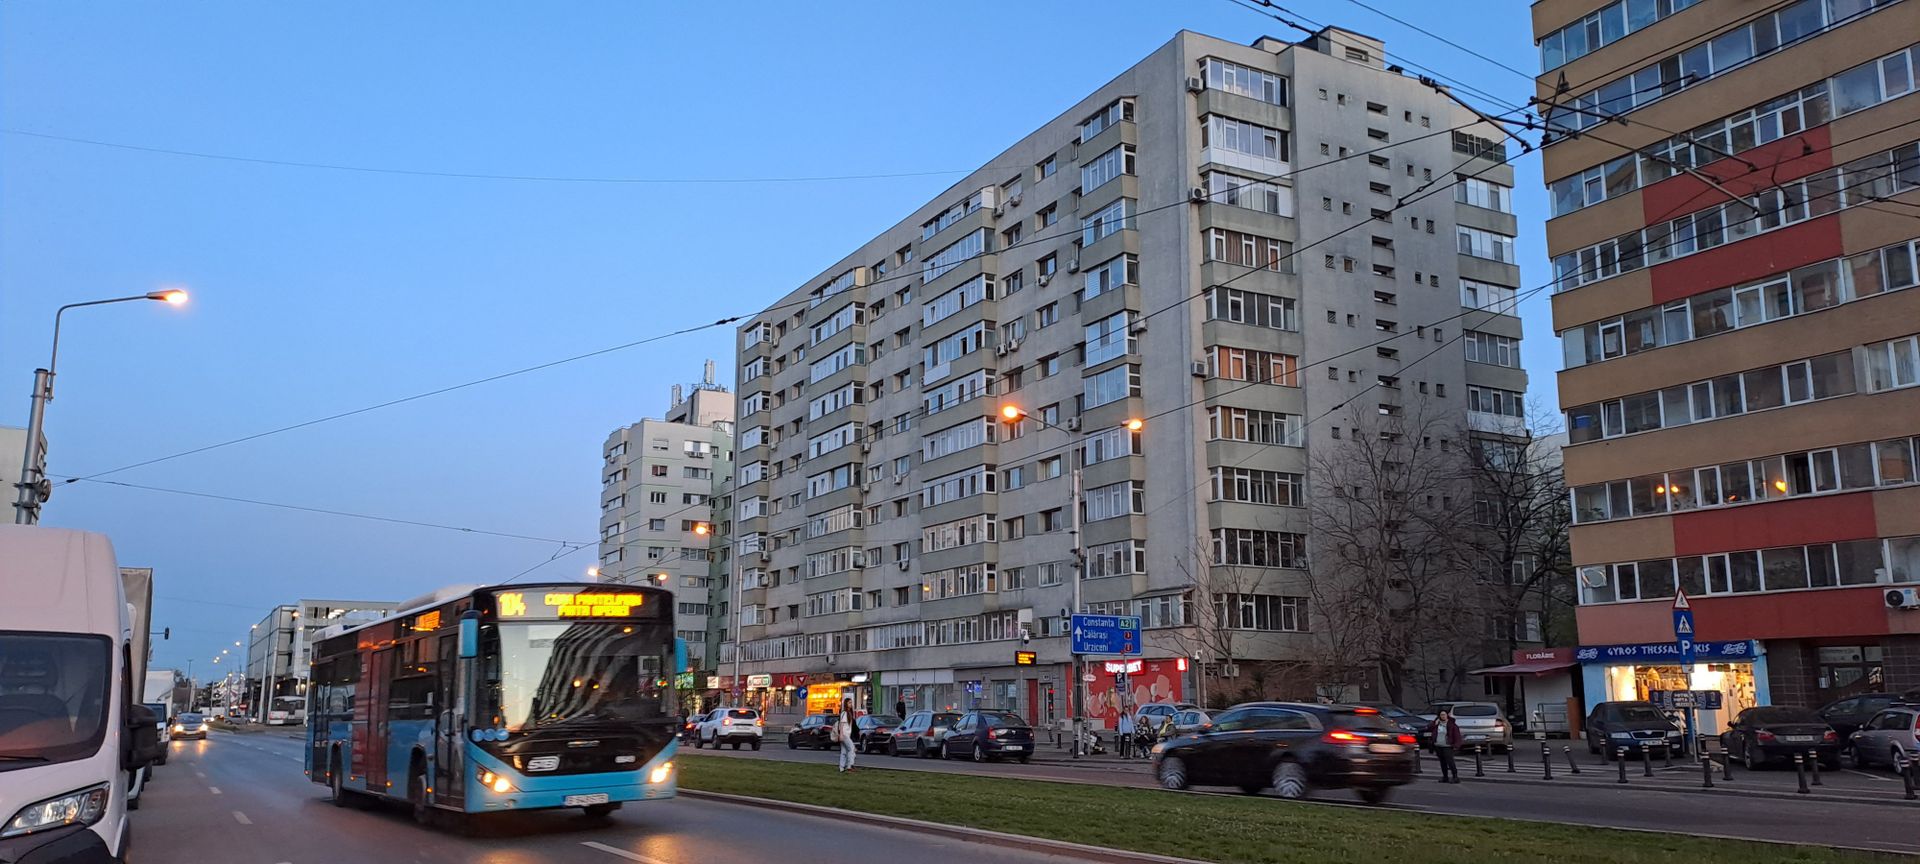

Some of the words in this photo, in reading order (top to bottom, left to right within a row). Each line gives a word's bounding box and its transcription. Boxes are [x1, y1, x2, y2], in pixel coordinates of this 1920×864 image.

[499, 592, 526, 616] 104
[1120, 620, 1130, 628] A2
[1083, 642, 1108, 651] Urziceni
[1682, 640, 1690, 655] P
[1607, 647, 1637, 656] GYROS
[1117, 673, 1123, 682] P
